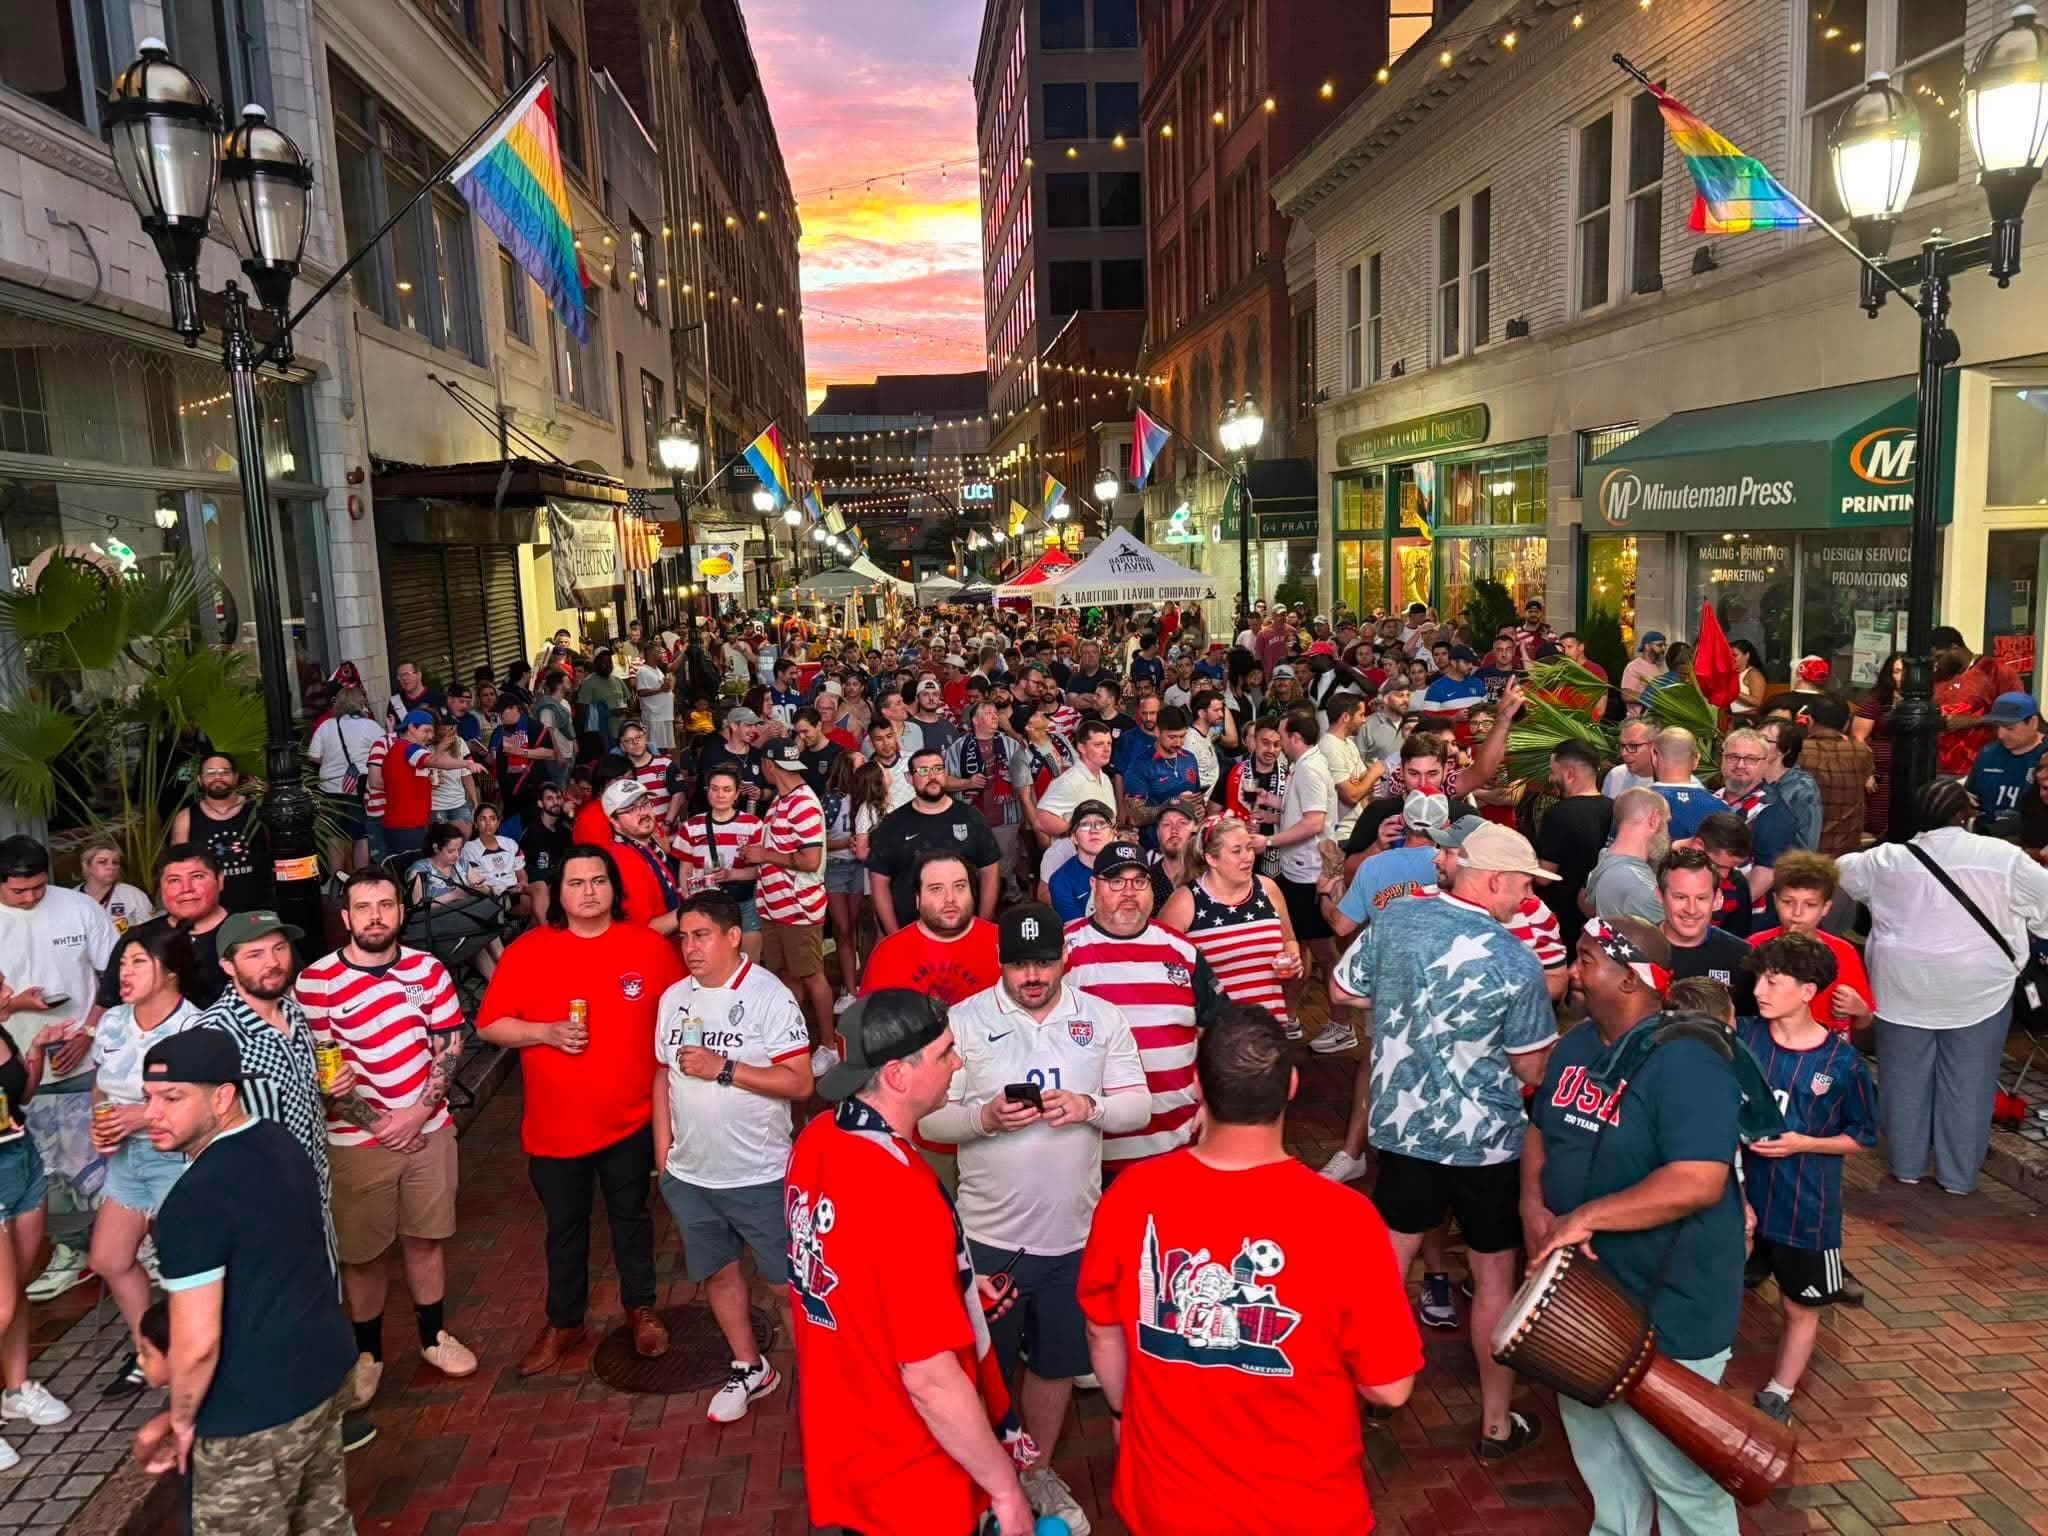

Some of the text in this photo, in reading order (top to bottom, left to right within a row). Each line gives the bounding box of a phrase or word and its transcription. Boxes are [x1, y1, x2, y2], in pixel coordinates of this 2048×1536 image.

[1642, 483, 1736, 510] Minuteman
[1841, 494, 1915, 514] PRINTIN
[1262, 521, 1276, 532] 64
[1699, 547, 1784, 561] MAILING PRINTING
[1823, 547, 1863, 562] DESIGN
[1714, 569, 1765, 583] MARKETING
[1832, 572, 1908, 587] PROMOTIONS
[1075, 589, 1118, 604] HARTFORD
[1159, 585, 1201, 600] COMPANY
[1995, 785, 2021, 808] 14
[669, 1028, 744, 1048] Erates
[790, 1029, 808, 1042] MS
[1551, 1065, 1628, 1128] USA
[1576, 1117, 1600, 1133] YEARS
